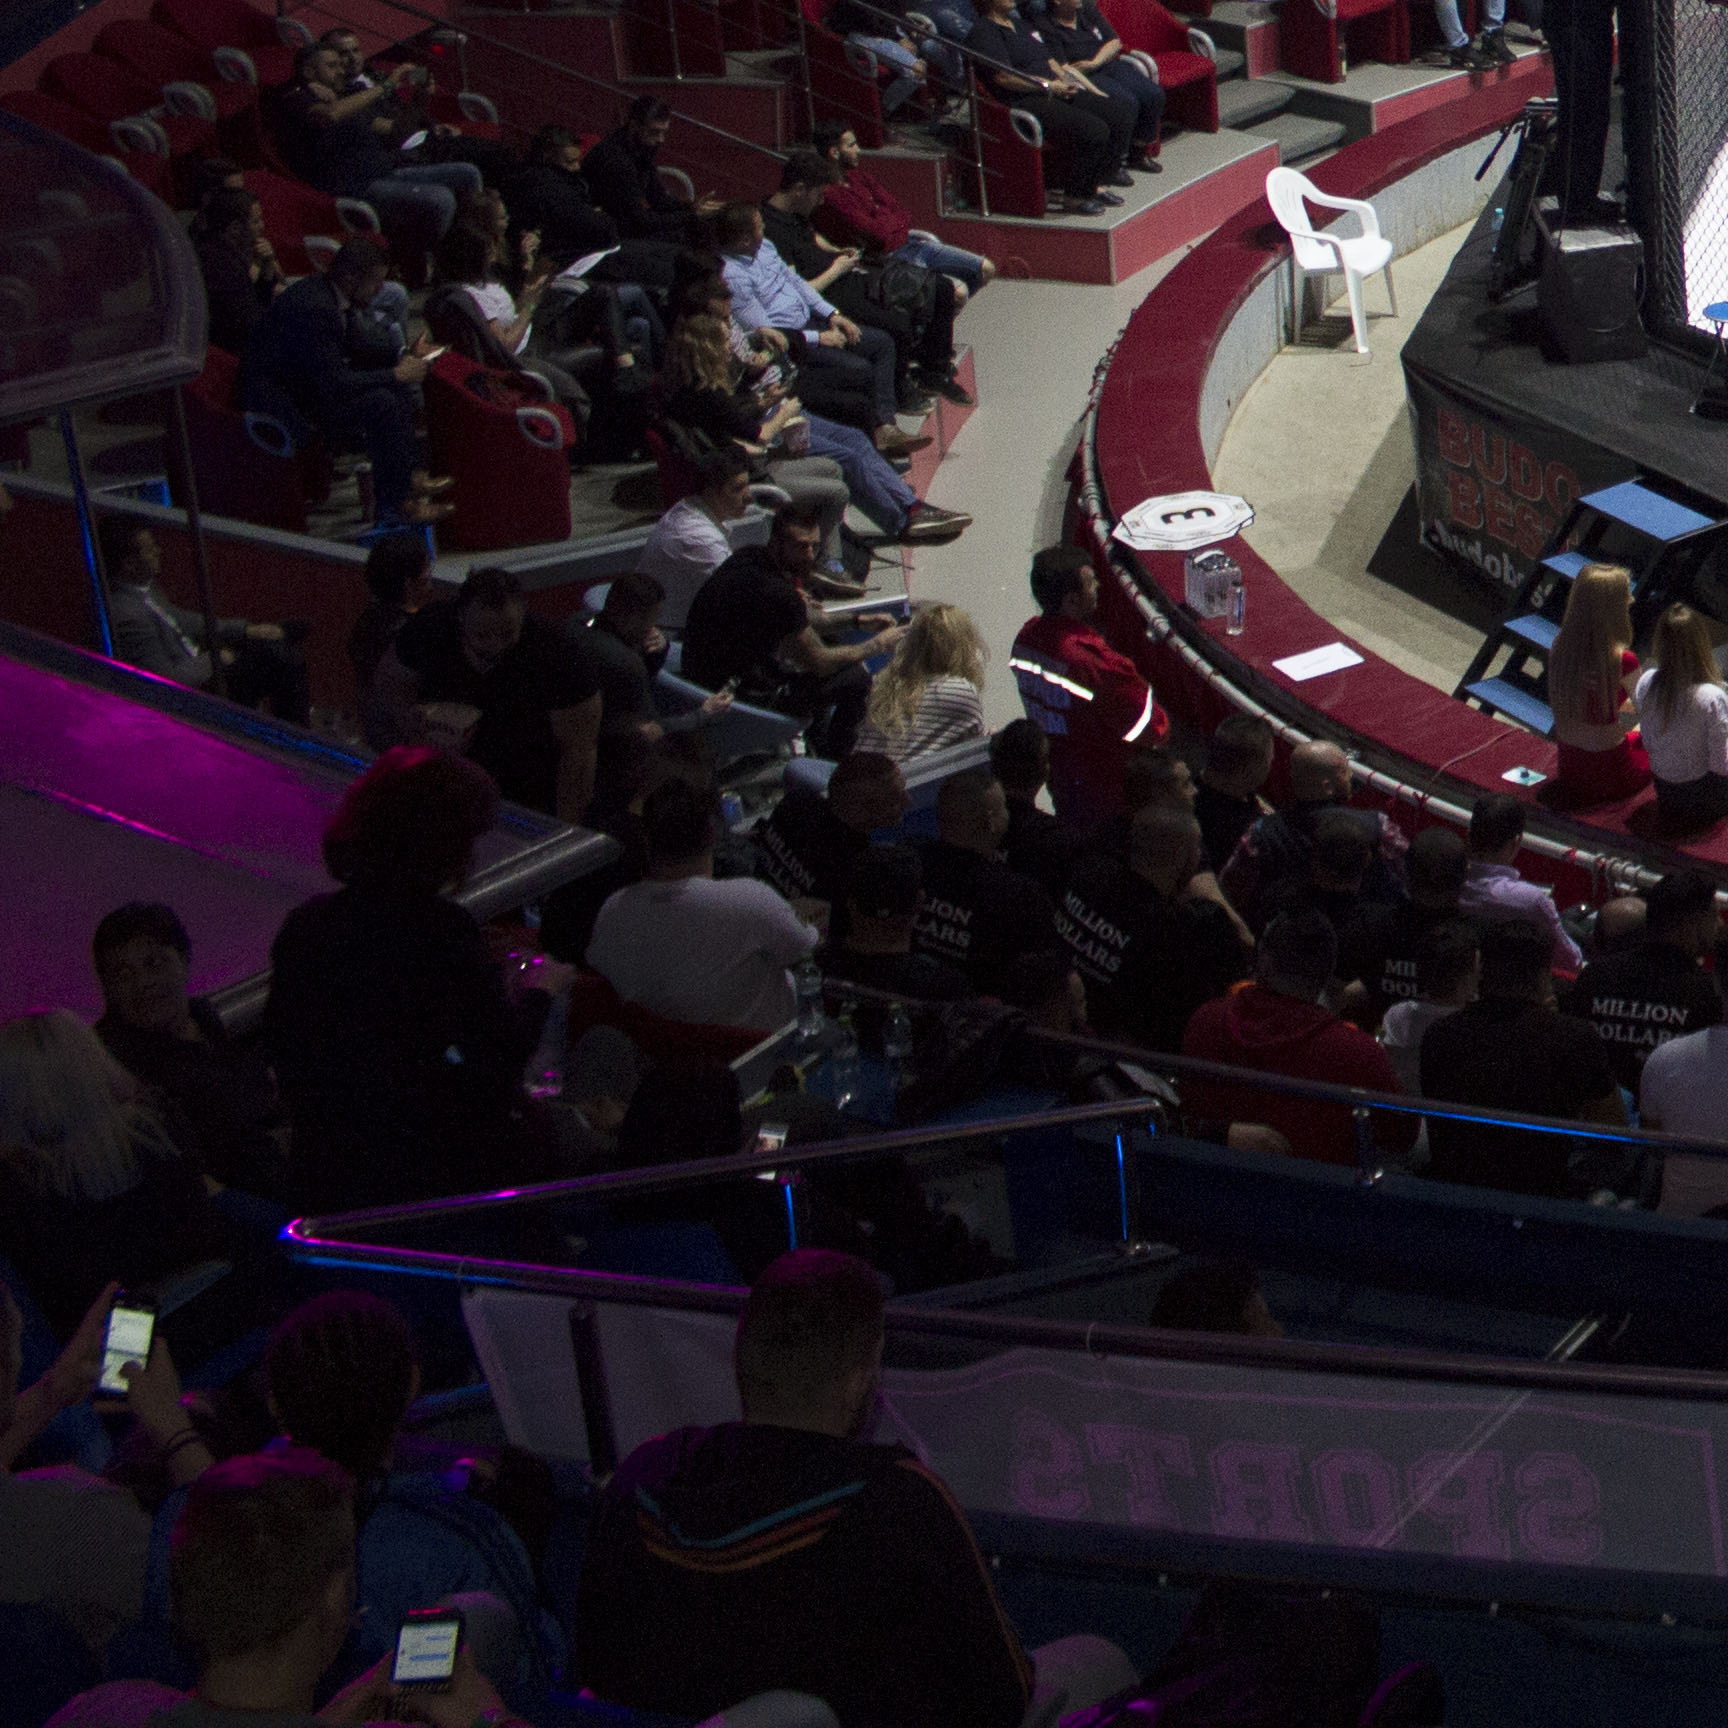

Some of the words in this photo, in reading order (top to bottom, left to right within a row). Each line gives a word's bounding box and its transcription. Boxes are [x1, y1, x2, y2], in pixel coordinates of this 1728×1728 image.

[1436, 407, 1582, 516] BUDO
[1063, 889, 1132, 950] MILLION
[1591, 997, 1690, 1027] MILLION
